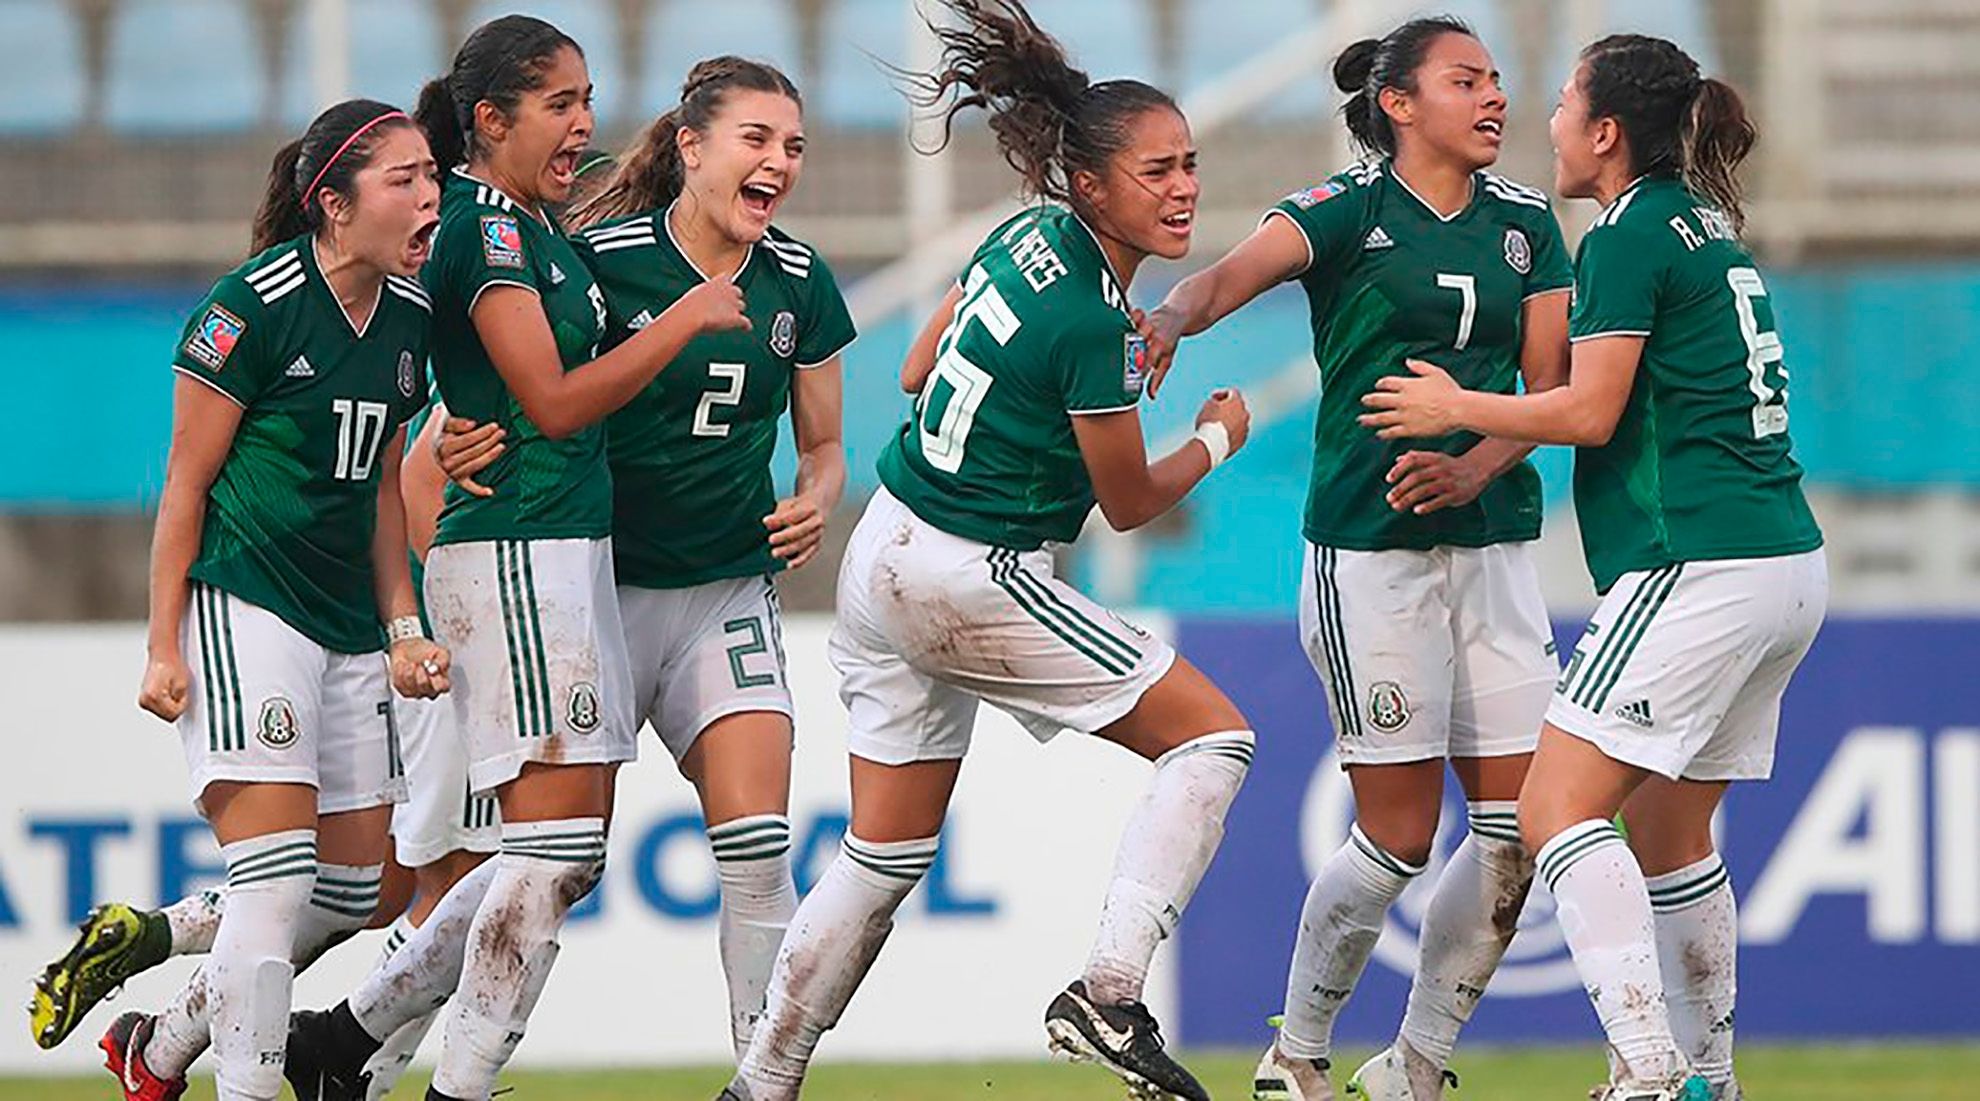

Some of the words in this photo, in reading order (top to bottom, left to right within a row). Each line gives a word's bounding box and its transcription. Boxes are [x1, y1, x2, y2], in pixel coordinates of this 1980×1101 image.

[1008, 227, 1068, 293] REYES
[1437, 273, 1476, 350] 7
[1727, 267, 1788, 439] 6
[692, 363, 745, 436] 2
[333, 400, 388, 480] 10
[724, 617, 776, 689] 2
